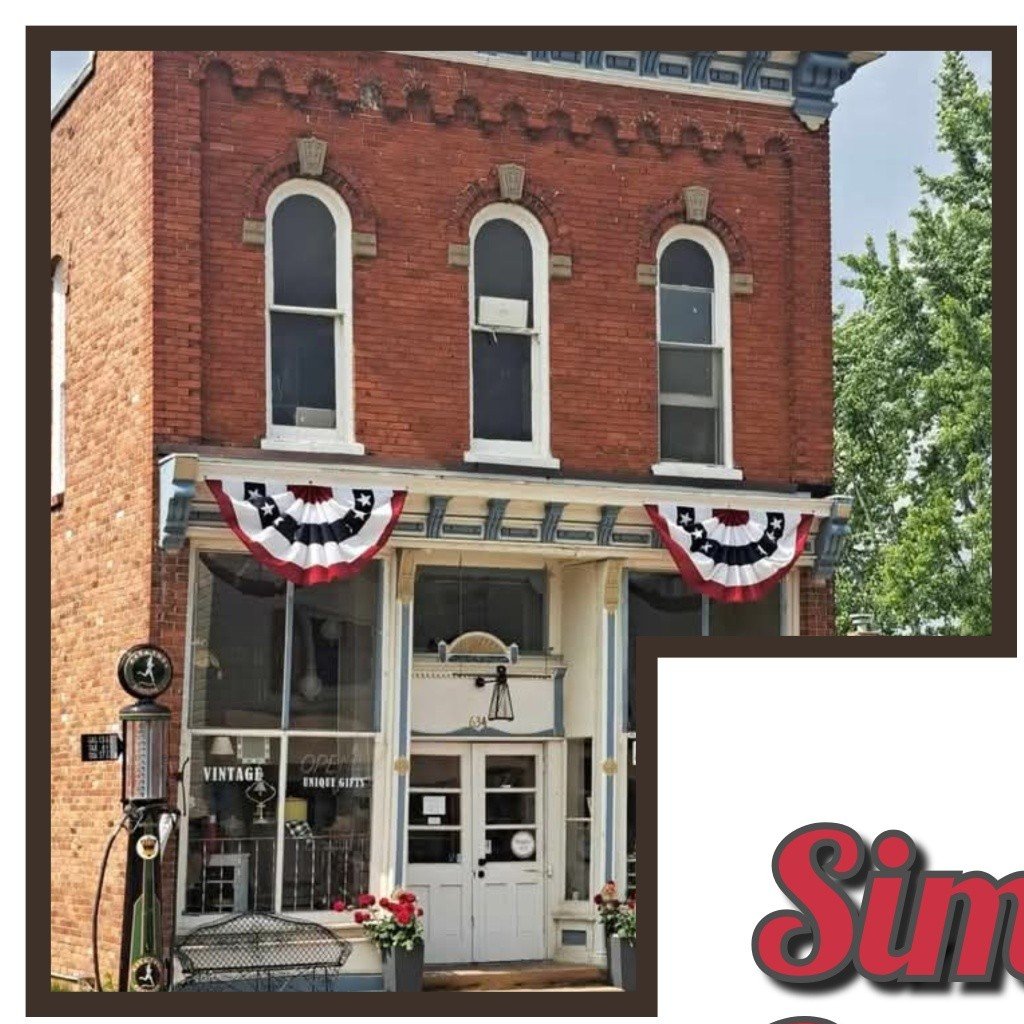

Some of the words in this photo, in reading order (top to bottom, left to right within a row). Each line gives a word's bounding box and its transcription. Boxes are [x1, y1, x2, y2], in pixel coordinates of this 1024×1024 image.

[469, 714, 487, 728] 634
[203, 766, 264, 782] VINTAGE
[303, 777, 335, 788] UNIQUE
[337, 777, 365, 788] GIFTS
